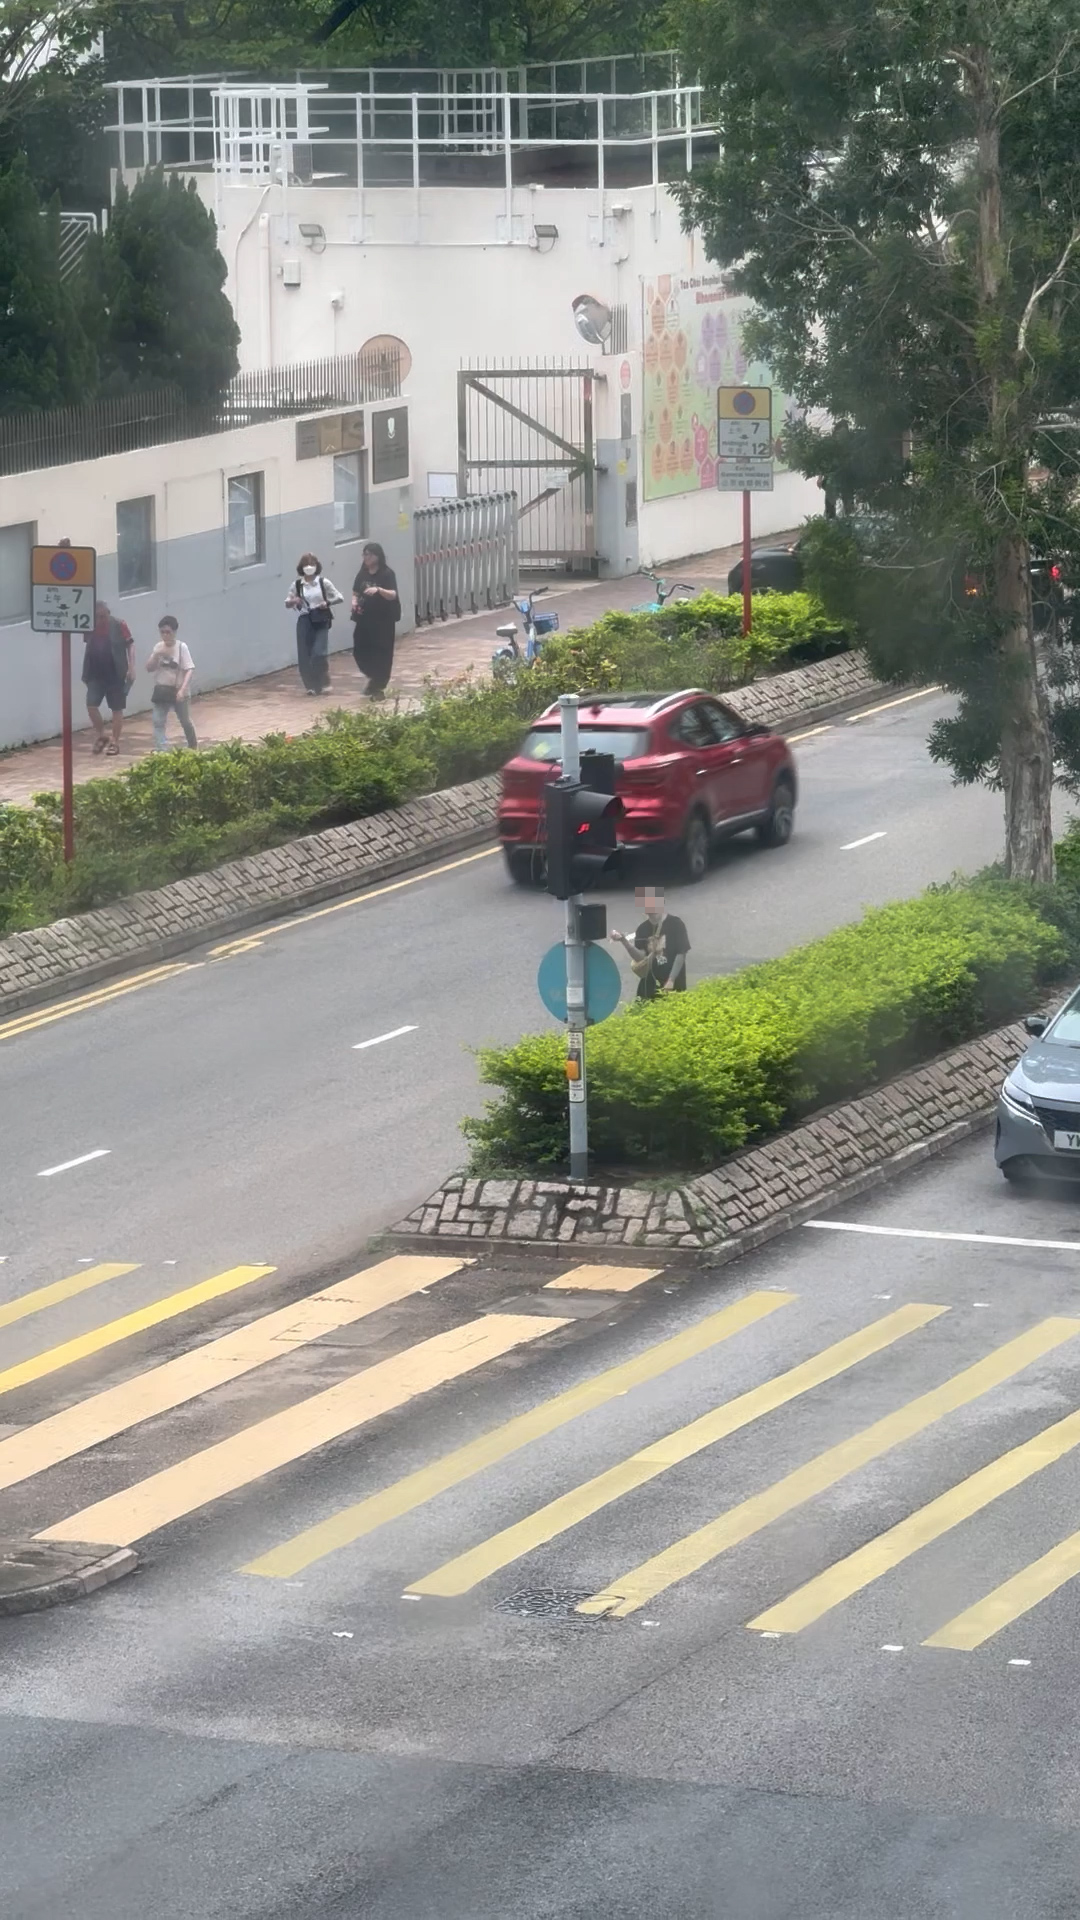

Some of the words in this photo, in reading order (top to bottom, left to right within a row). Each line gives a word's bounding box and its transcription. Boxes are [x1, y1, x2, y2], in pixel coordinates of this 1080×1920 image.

[751, 422, 760, 434] 7
[752, 442, 769, 455] 12
[43, 594, 62, 603] 上午
[72, 588, 83, 604] 7
[72, 614, 90, 629] 12
